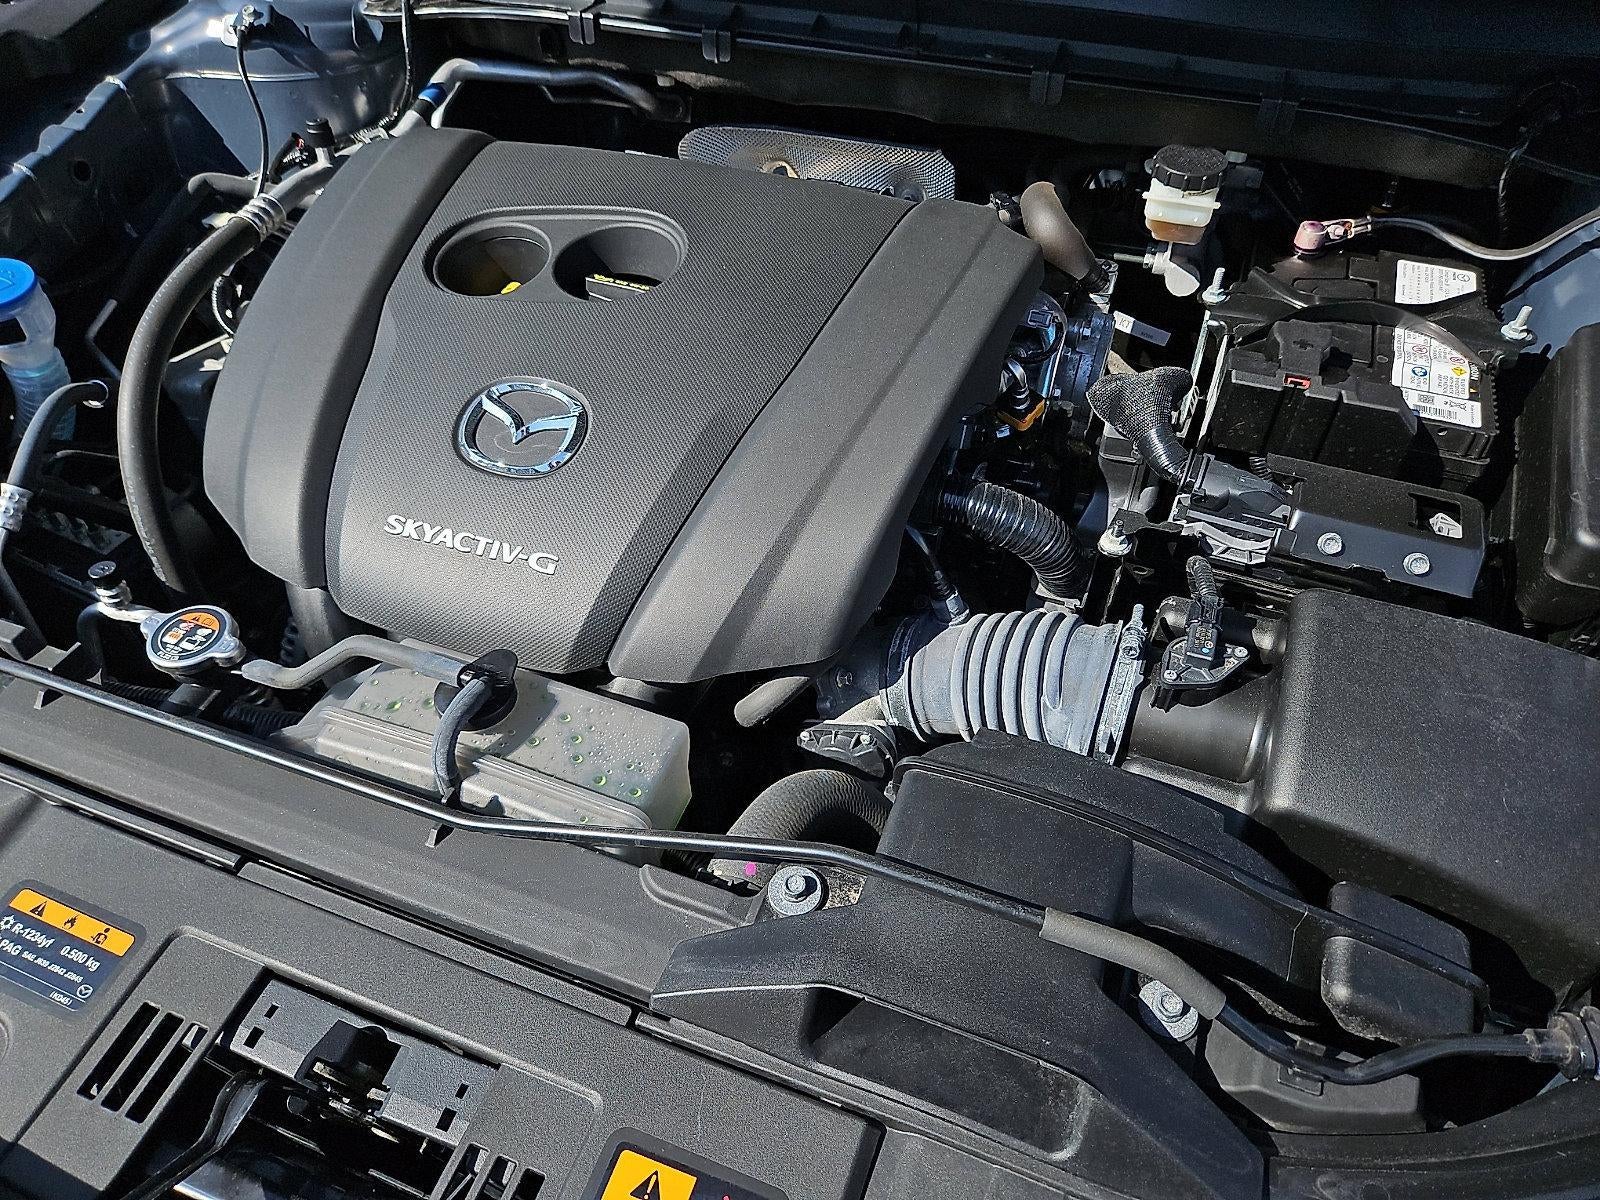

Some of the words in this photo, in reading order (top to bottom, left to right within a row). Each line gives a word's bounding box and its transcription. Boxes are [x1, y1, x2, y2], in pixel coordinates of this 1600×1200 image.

[383, 514, 560, 576] SKYACTIV-G
[0, 938, 22, 956] PAG
[21, 950, 37, 962] SAE
[11, 922, 55, 948] R-1234yf
[60, 945, 86, 964] 0.500
[85, 956, 101, 972] kg
